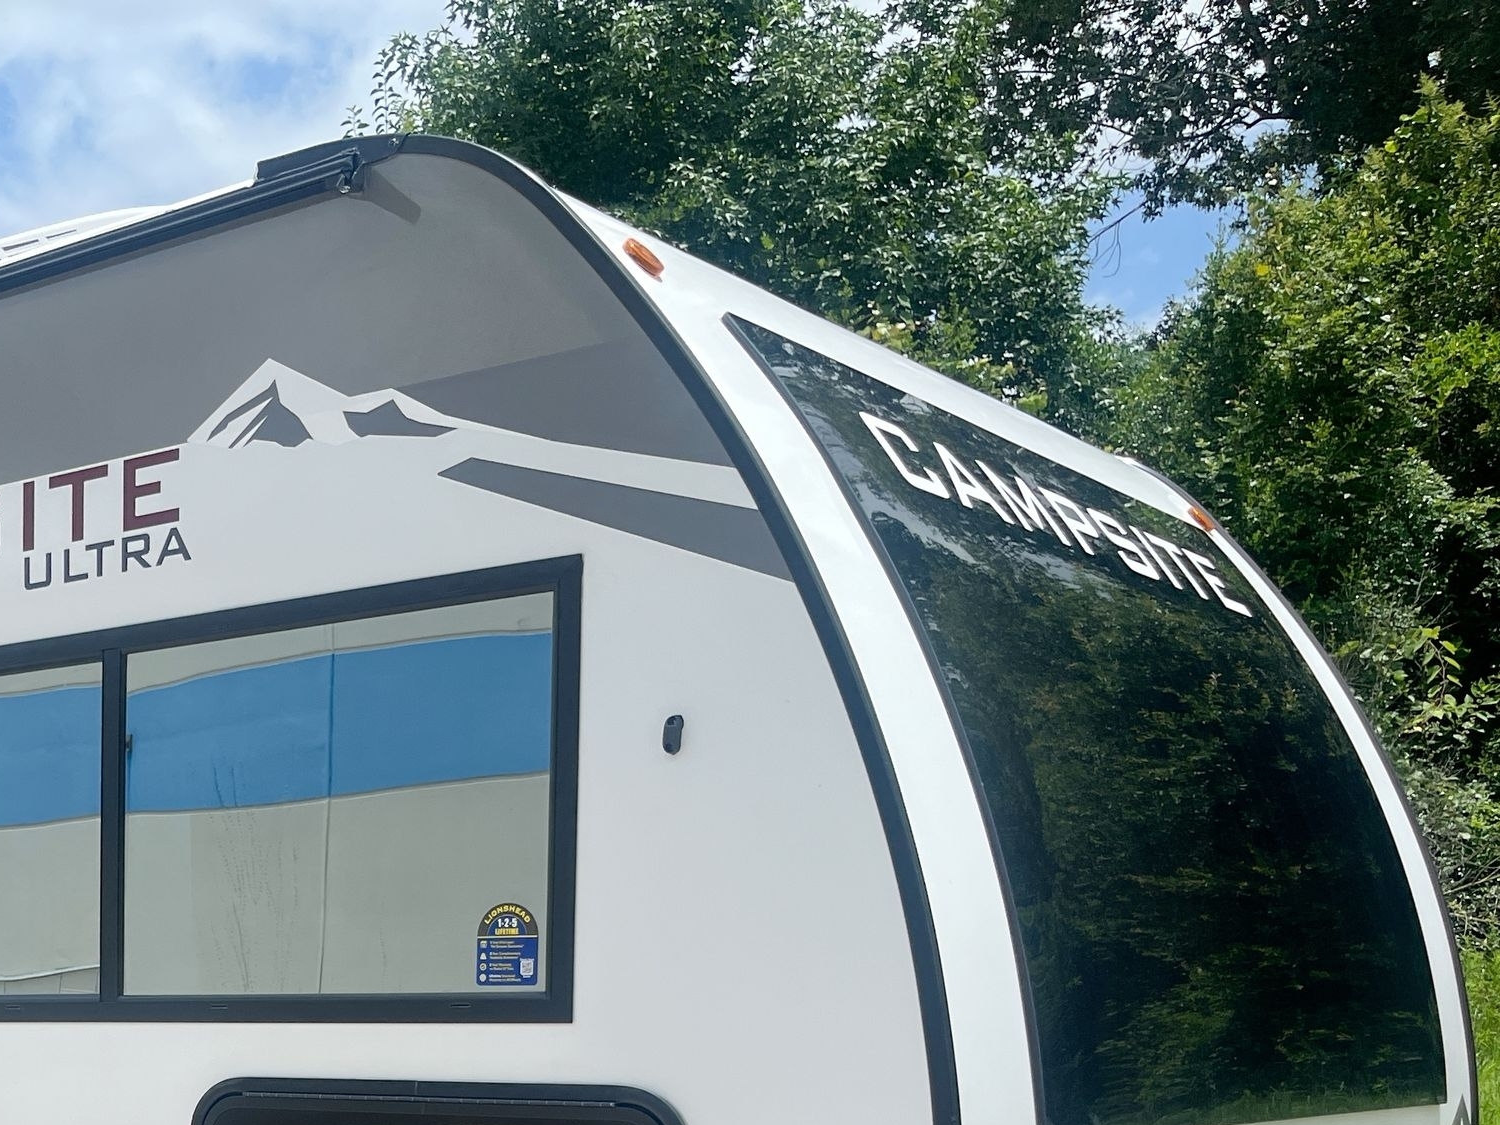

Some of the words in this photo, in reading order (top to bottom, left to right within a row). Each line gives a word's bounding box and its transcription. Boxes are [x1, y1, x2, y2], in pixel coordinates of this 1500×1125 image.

[858, 411, 1253, 618] CAMPSITE
[24, 527, 192, 590] ULTRA
[484, 905, 531, 924] LIONSHEAD
